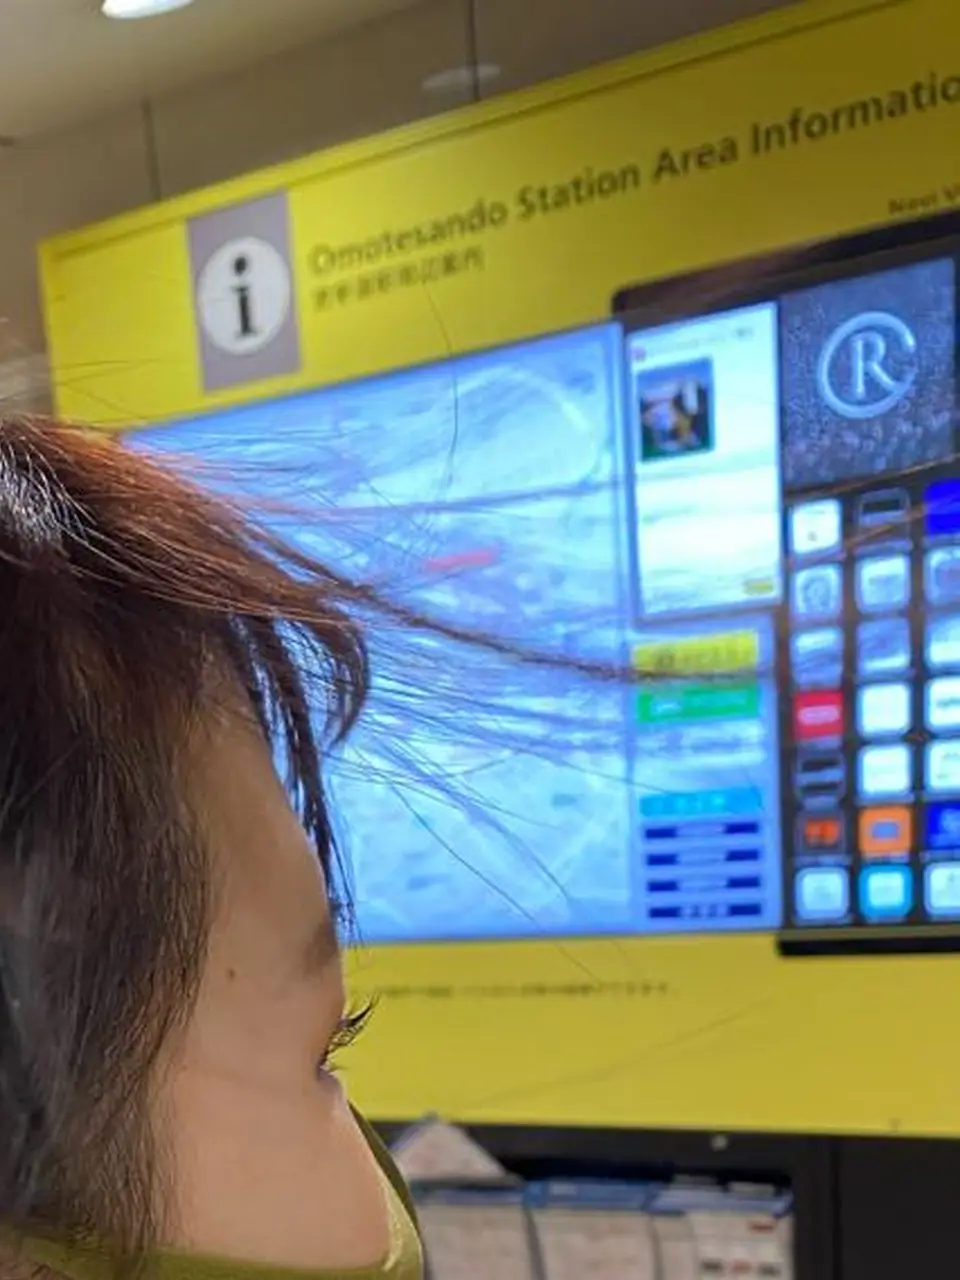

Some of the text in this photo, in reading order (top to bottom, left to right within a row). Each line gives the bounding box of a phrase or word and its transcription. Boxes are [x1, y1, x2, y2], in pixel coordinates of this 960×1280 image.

[308, 199, 508, 276] Omotesando
[516, 164, 640, 222] Station
[651, 135, 738, 184] Area
